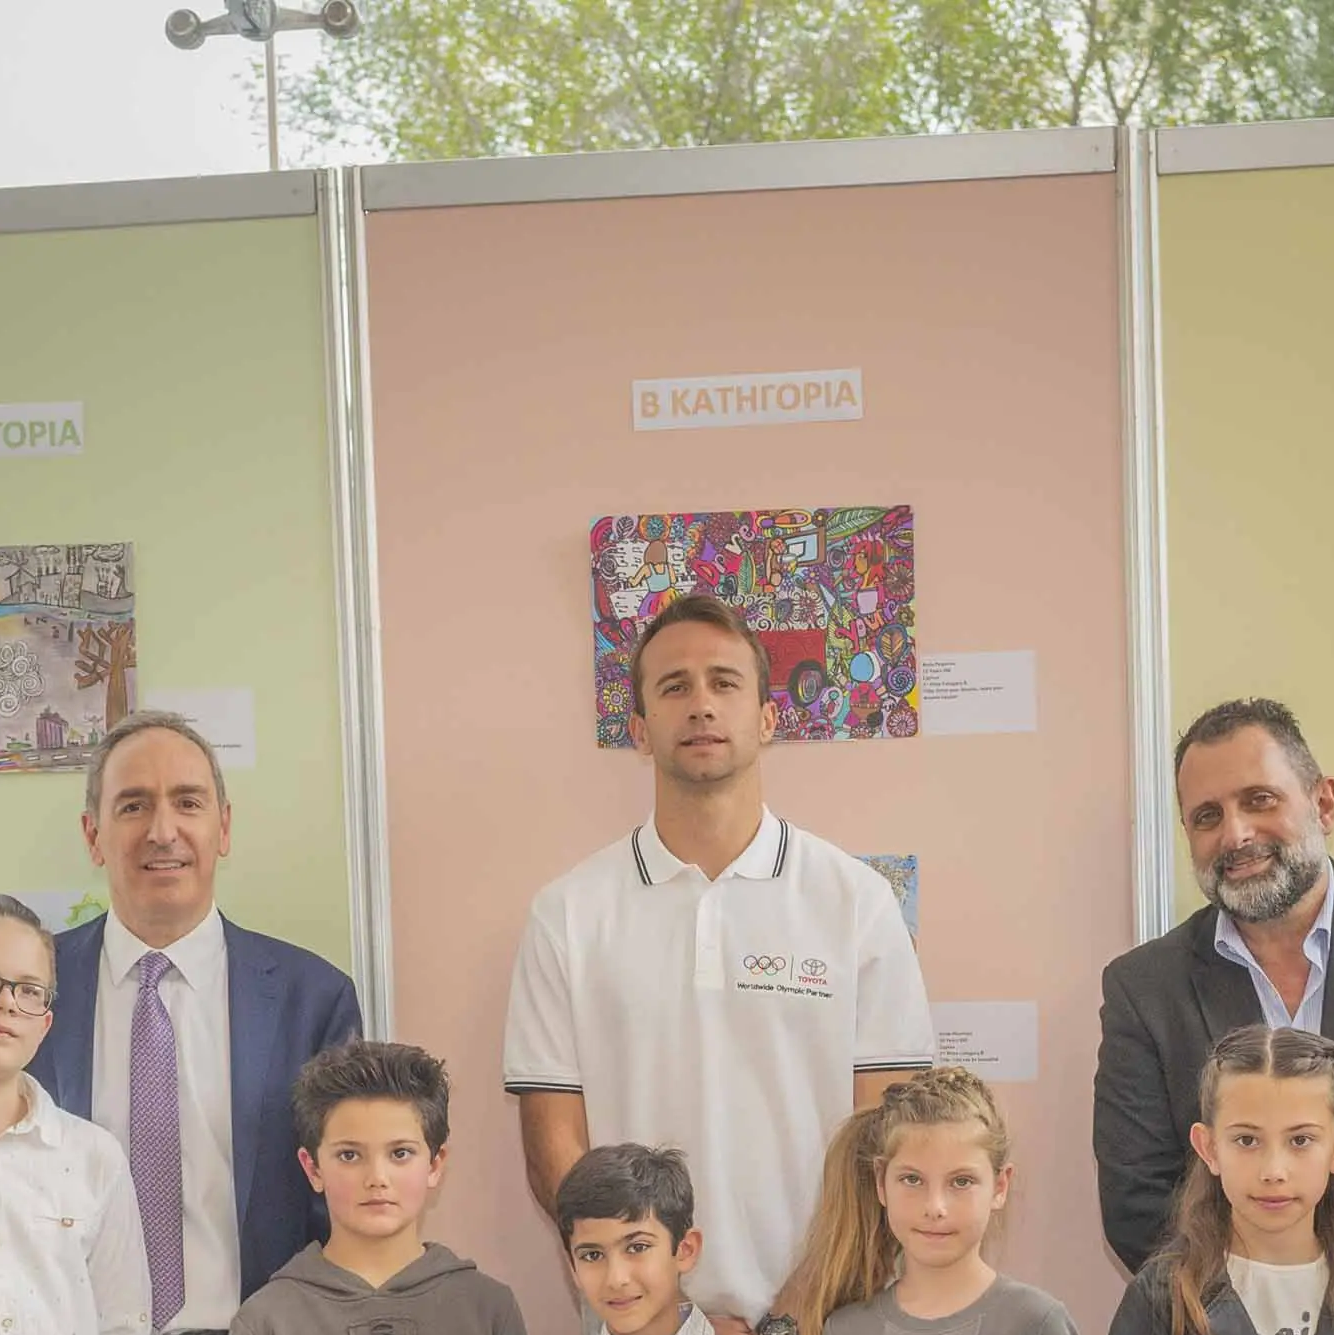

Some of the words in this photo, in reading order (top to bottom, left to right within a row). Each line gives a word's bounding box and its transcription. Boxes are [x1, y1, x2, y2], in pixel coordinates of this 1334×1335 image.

[640, 389, 660, 419] Β
[671, 379, 858, 418] ΚΑΤΗΓΟΡΙΑ
[797, 975, 828, 986] TOYOTA
[737, 981, 775, 992] Worldwide
[776, 984, 806, 996] Olympic
[806, 987, 834, 999] Partner
